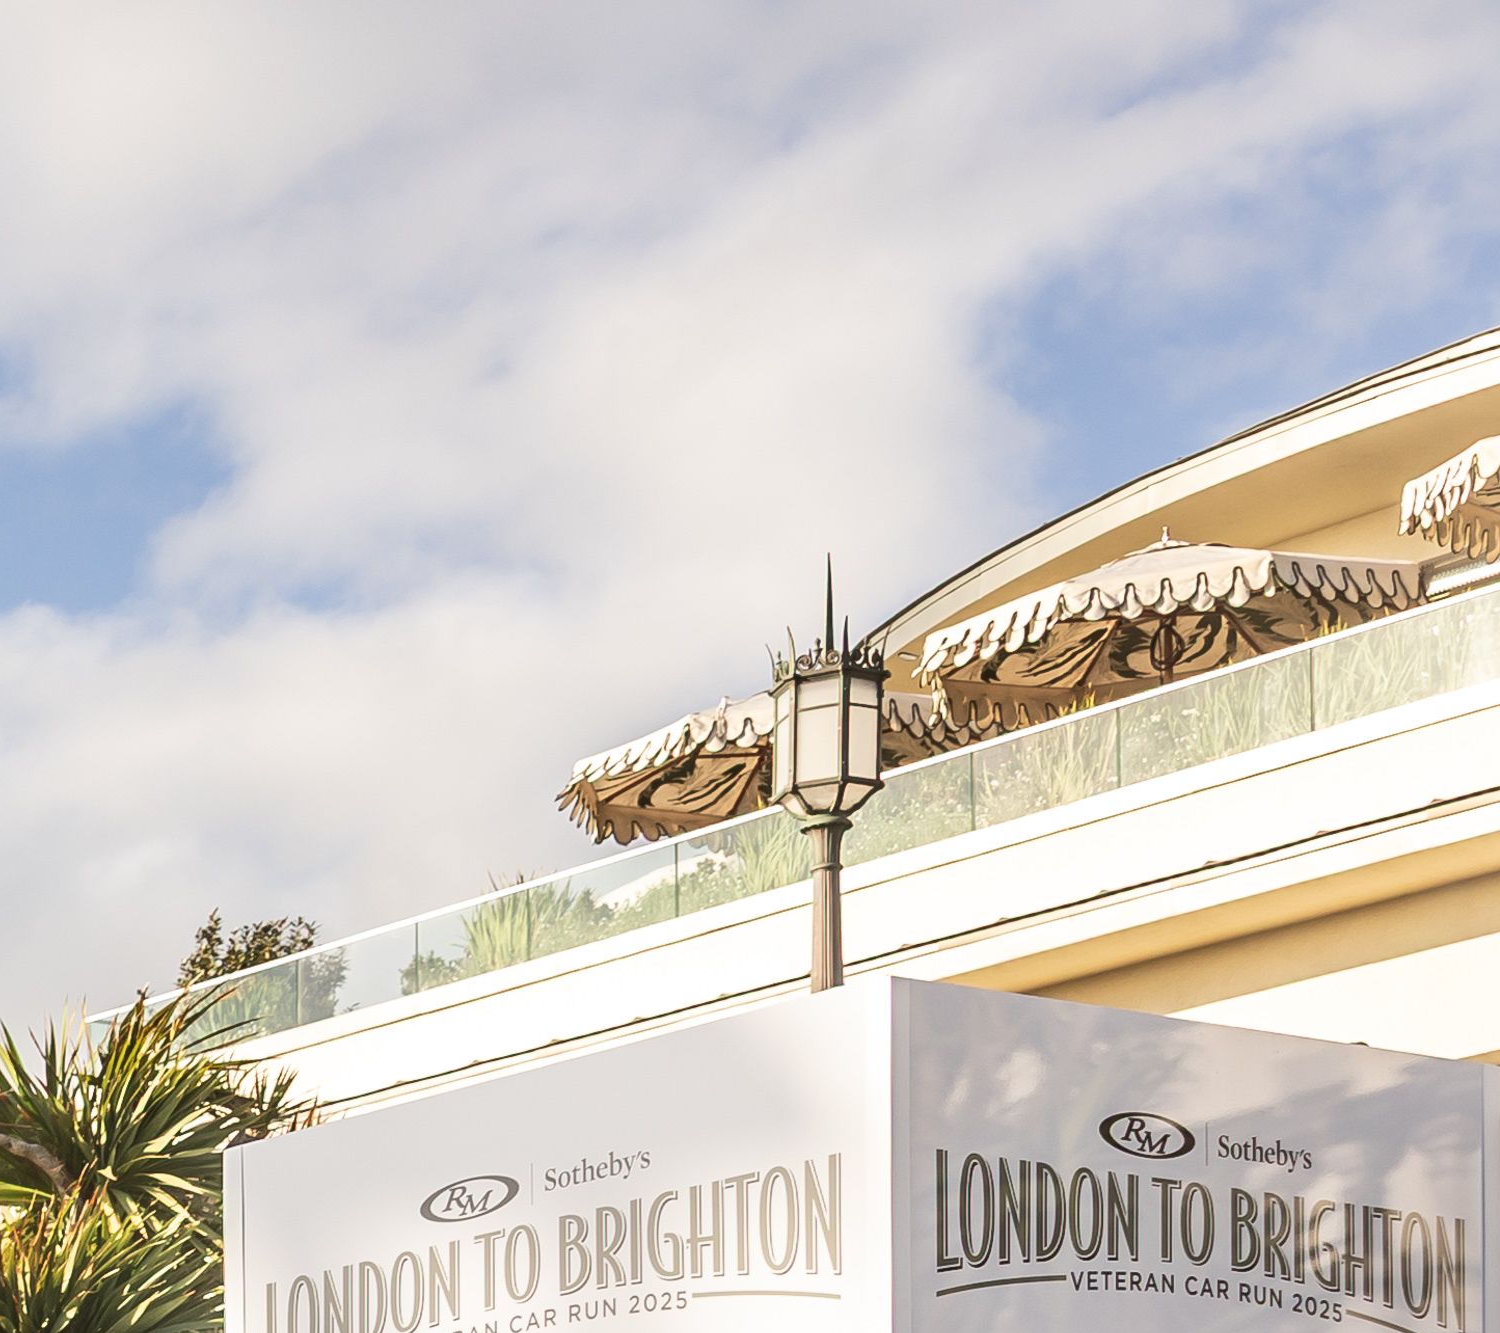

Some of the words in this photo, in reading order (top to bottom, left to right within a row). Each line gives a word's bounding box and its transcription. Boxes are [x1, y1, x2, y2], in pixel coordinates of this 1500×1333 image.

[1121, 1118, 1170, 1156] RM
[1217, 1135, 1313, 1172] Sotheby's
[440, 1187, 495, 1217] RM
[544, 1146, 651, 1191] Sotheby's
[936, 1149, 1139, 1272] LONDON
[1152, 1177, 1215, 1267] TO
[474, 1224, 542, 1309] TO
[557, 1153, 843, 1298] BRIGHTON
[510, 1308, 560, 1333] CAR
[568, 1299, 619, 1324] RUN
[629, 1290, 689, 1315] 2025
[1070, 1270, 1175, 1294] VETERAN
[1185, 1275, 1228, 1298] CAR
[1240, 1284, 1283, 1309] RUN
[1293, 1293, 1343, 1323] 2025
